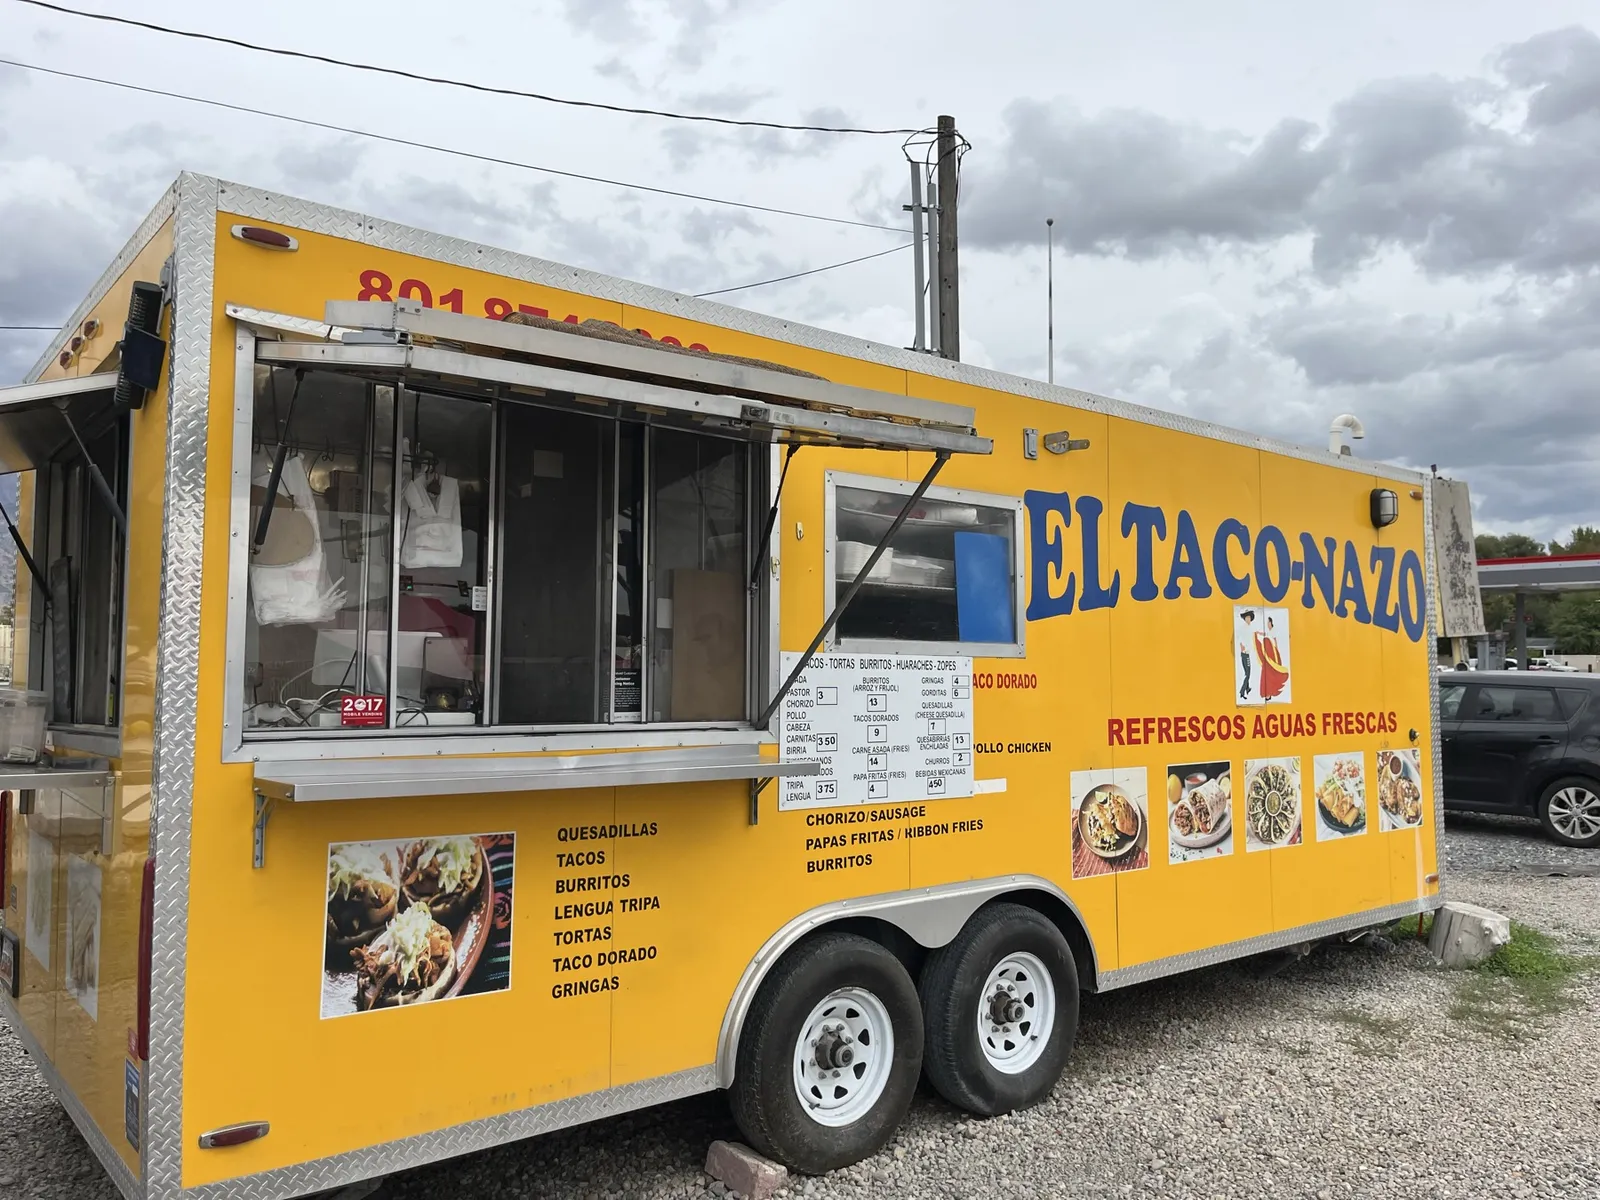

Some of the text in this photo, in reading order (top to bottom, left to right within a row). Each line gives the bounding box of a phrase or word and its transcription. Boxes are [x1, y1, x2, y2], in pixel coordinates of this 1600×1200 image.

[358, 270, 463, 314] 801
[1024, 489, 1426, 642] EL TACO-NAZO
[805, 658, 824, 669] ACOS
[829, 658, 855, 669] TORTAS
[860, 659, 892, 670] BURRITOS
[896, 660, 933, 670] HUARACHES
[937, 660, 957, 671] ZOPES
[954, 677, 959, 685] 4
[972, 673, 1037, 689] ACO DORADO
[786, 688, 824, 700] PASTOR 3
[853, 685, 873, 693] (ARROZ
[954, 689, 959, 697] 6
[343, 698, 383, 711] 2017
[786, 700, 814, 708] CHORIZO
[869, 697, 878, 706] 13
[786, 711, 807, 720] POLLO
[853, 714, 899, 722] TACOS DORADOS
[915, 711, 965, 719] (CHEESE QUESADILLA)
[786, 723, 811, 732] CABEZA
[874, 728, 880, 737] 9
[1108, 711, 1397, 746] REFRESCOS AGUAS FRESCAS
[786, 734, 836, 746] CARNITAS 350
[916, 735, 965, 744] QUESABIRRIAS 13
[786, 746, 807, 755] BIRRIA
[852, 746, 871, 754] CARNE
[891, 745, 910, 753] (FRIES)
[920, 743, 949, 751] ENCHILADAS
[1007, 742, 1052, 754] CHICKEN
[869, 757, 879, 766] 14
[925, 753, 963, 765] CHURROS 2
[853, 771, 907, 781] PAPA FRITAS (FRIES)
[915, 768, 966, 778] BEBIDAS MEXICANAS
[786, 781, 835, 794] TRIPA 375
[869, 784, 875, 792] 4
[928, 779, 943, 788] 450
[786, 792, 811, 802] LENGUA
[806, 806, 926, 827] CHORIZO/SAUSAGE
[557, 822, 658, 842] QUESADILLAS
[806, 835, 847, 851] PAPAS
[851, 829, 894, 845] FRITAS
[905, 823, 949, 839] RIBBON
[952, 819, 984, 833] FRIES
[556, 850, 606, 868] TACOS
[807, 854, 873, 873] BURRITOS
[555, 874, 630, 894] BURRITOS
[554, 896, 661, 920] LENGUA TRIPA
[553, 926, 612, 946] TORTAS
[552, 945, 657, 972] TACO DORADO
[551, 976, 620, 999] GRINGAS
